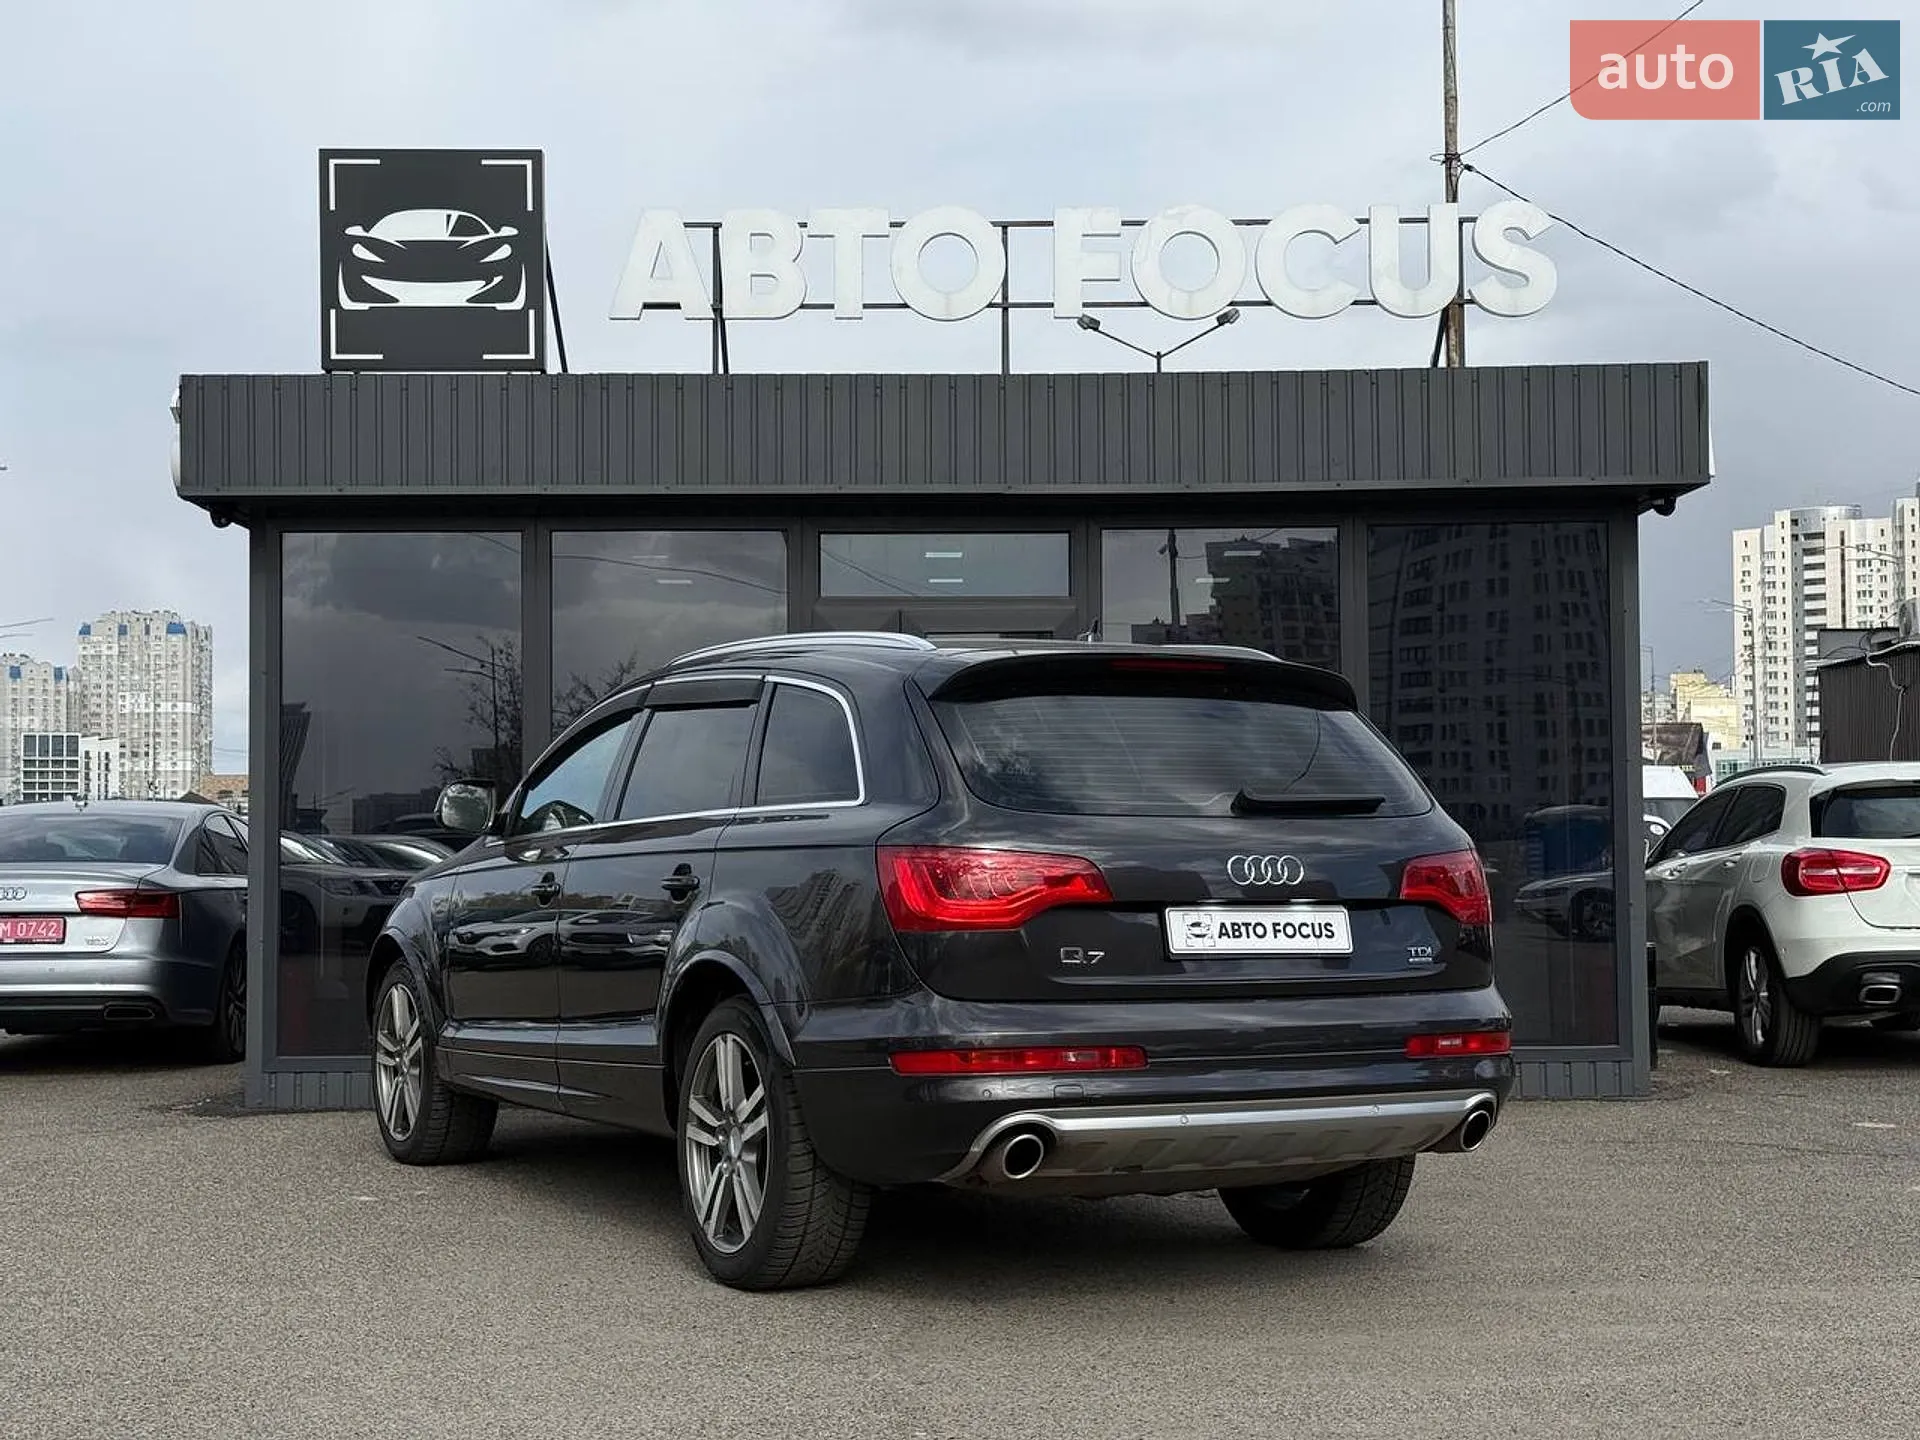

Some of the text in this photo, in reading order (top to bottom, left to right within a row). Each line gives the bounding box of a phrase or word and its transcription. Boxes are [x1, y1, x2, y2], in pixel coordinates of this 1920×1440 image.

[608, 200, 1559, 322] АВТО FOCUS
[17, 921, 57, 937] 0742
[1217, 921, 1336, 939] АВТО FOCUS
[1060, 946, 1105, 965] Q7
[1407, 946, 1432, 957] TDI
